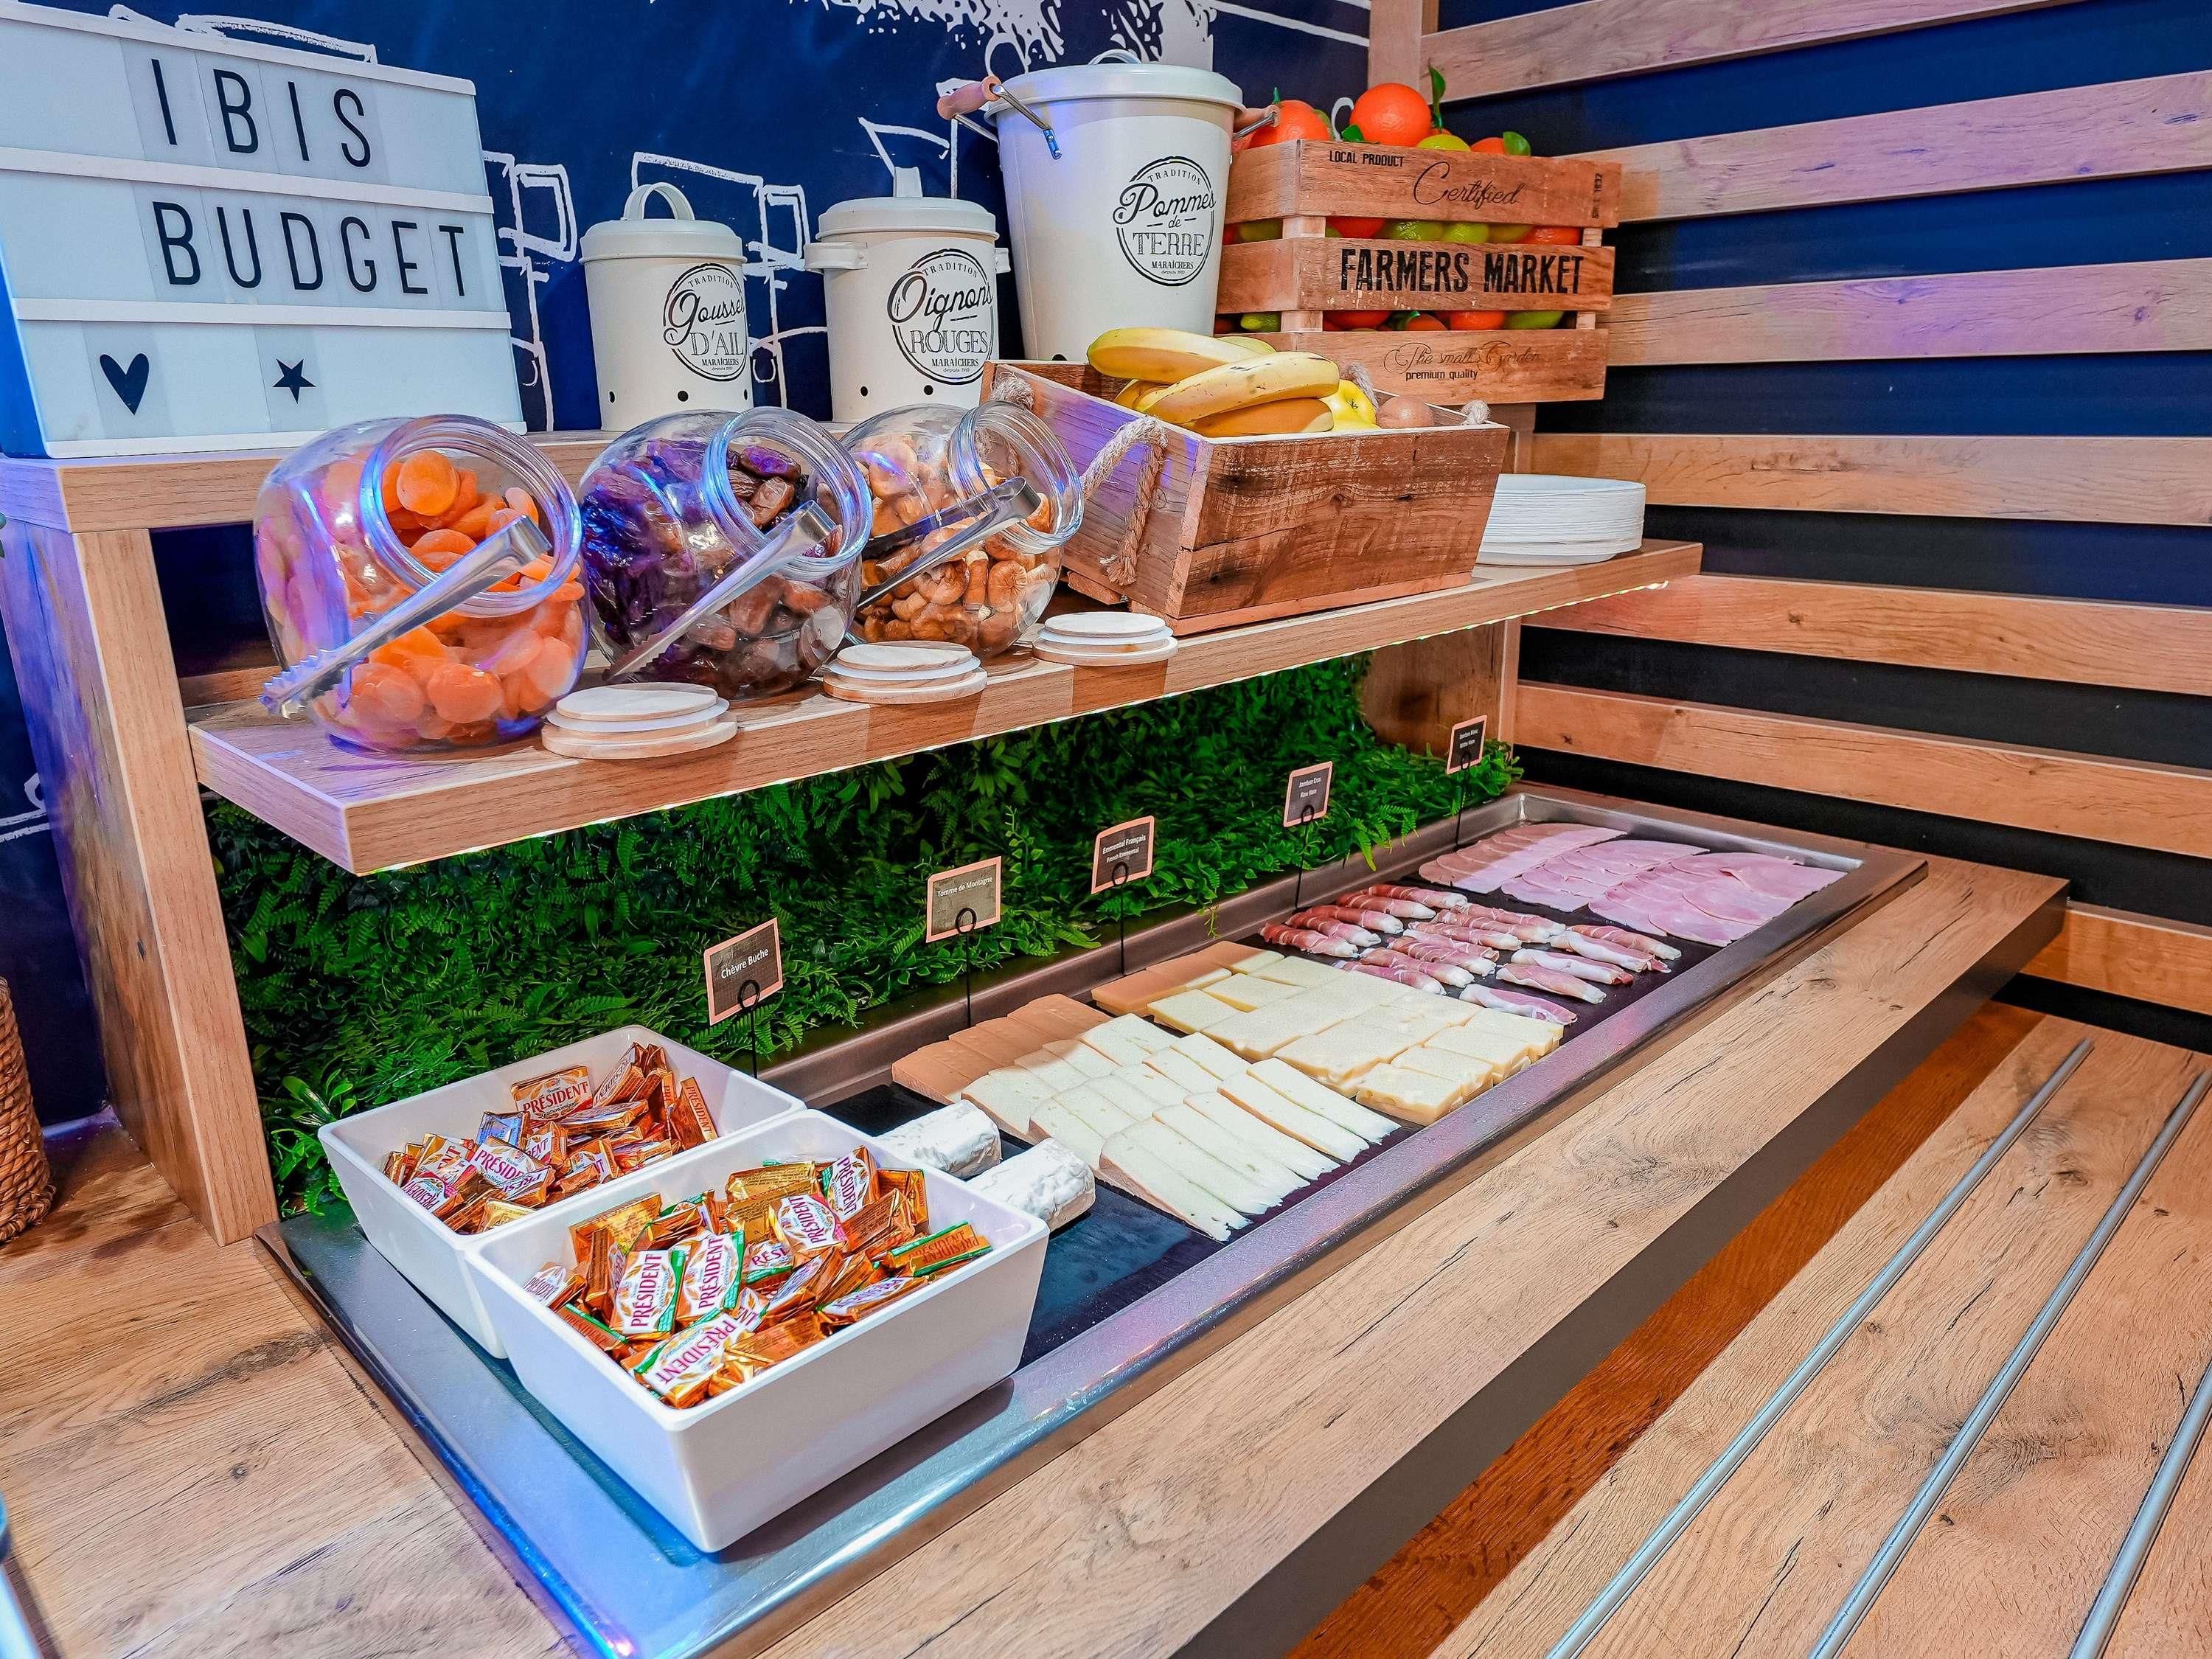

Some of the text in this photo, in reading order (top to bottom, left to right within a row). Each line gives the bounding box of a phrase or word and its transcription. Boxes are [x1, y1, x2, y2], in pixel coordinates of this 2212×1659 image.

[151, 59, 371, 167] IBIS
[1329, 150, 1405, 167] LOCAL PRODUCT
[1147, 169, 1201, 185] TRADITION
[1413, 161, 1525, 210] Certified
[1113, 183, 1217, 225] Pommes
[1169, 215, 1181, 229] de
[153, 201, 465, 296] BUDGET
[1133, 232, 1205, 257] TERRE
[688, 274, 734, 288] TRADITION
[922, 262, 978, 278] TRADITION
[1340, 248, 1585, 294] FARMERS MARKET
[887, 271, 993, 333] Oignons
[690, 330, 744, 356] D'AIL
[910, 330, 988, 354] ROUGES
[1384, 341, 1433, 376] The
[1438, 347, 1478, 364] small
[1405, 369, 1478, 382] premium quality
[937, 886, 958, 897] Tomme
[966, 876, 993, 889] Montagne
[720, 947, 769, 980] Chèvre Buche
[523, 1081, 588, 1113] PRÉSIDENT
[838, 1156, 858, 1215] PRÉSIDENT
[788, 1197, 827, 1244] PRÉSIDENT
[630, 1253, 662, 1327] PRÉSIDENT
[698, 1237, 725, 1310] PRÉSIDENT
[655, 1319, 737, 1385] PRÉSIDENT
